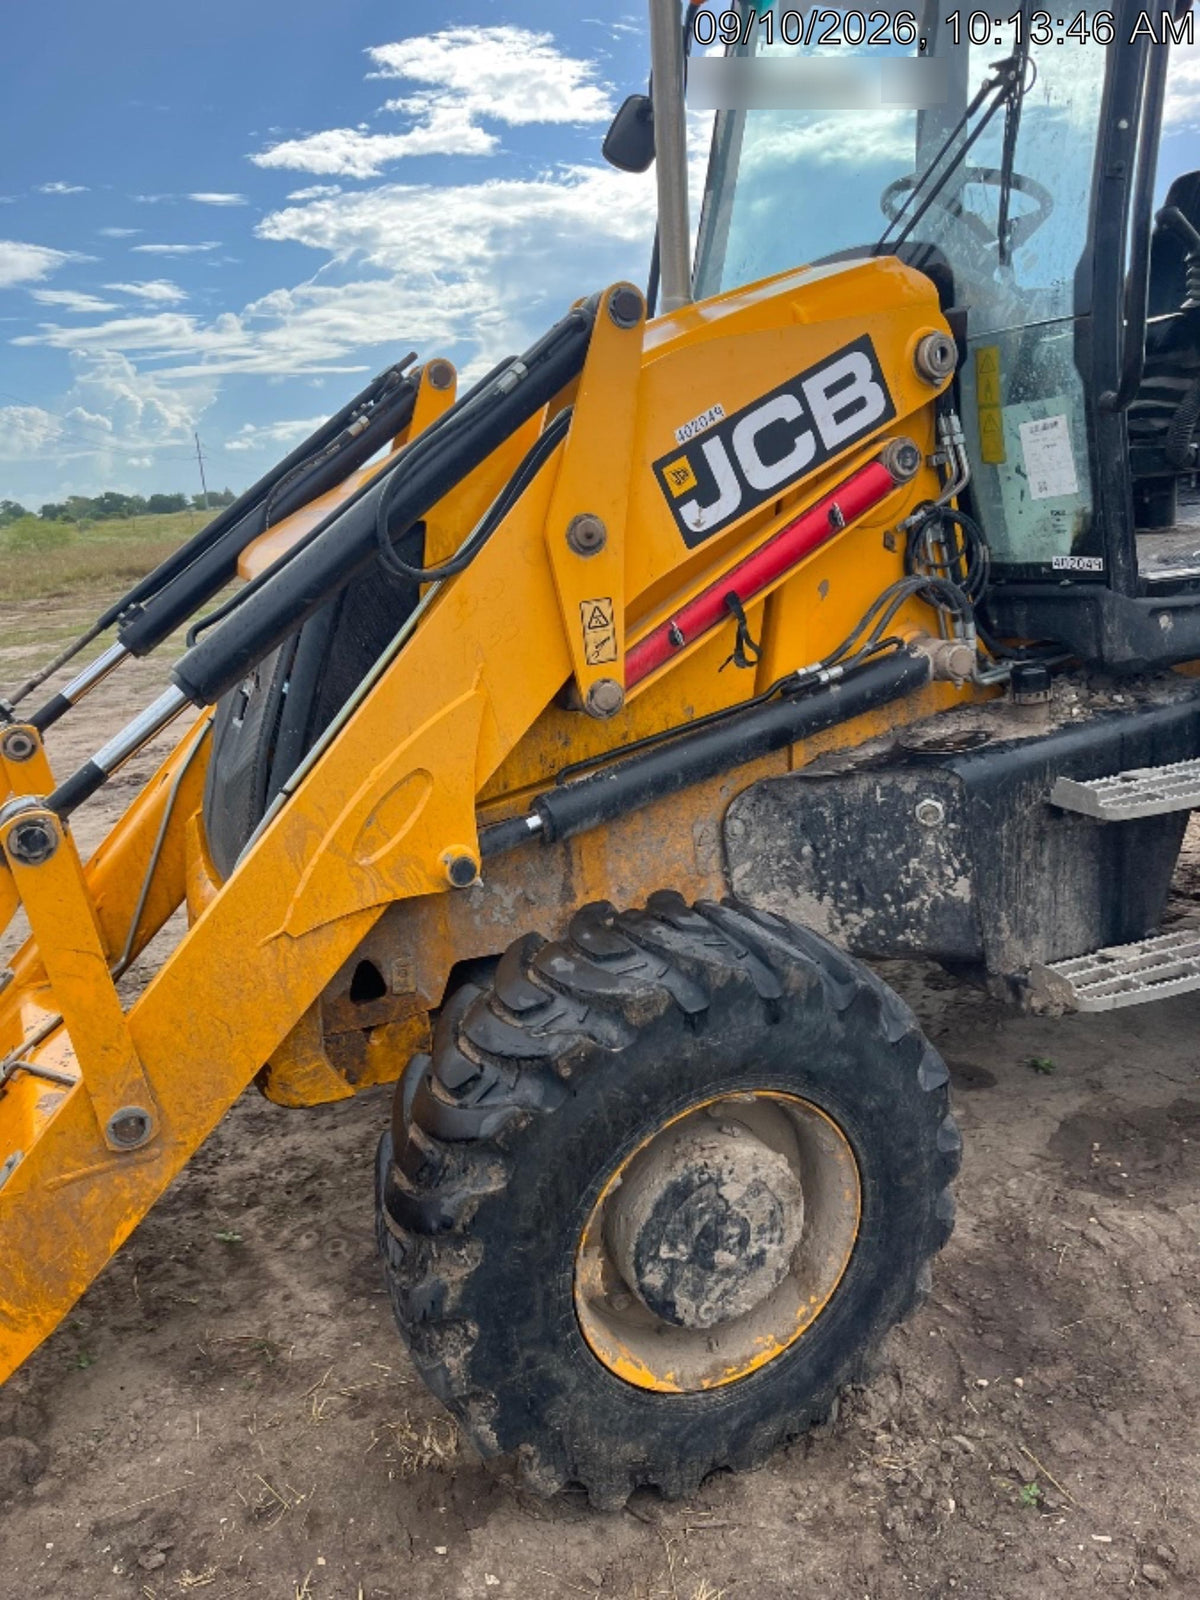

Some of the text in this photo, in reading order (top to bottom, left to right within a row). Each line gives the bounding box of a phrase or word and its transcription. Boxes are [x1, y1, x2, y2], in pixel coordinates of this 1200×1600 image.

[677, 405, 724, 442] 402049
[679, 352, 886, 532] JCB
[1054, 557, 1102, 570] 402049
